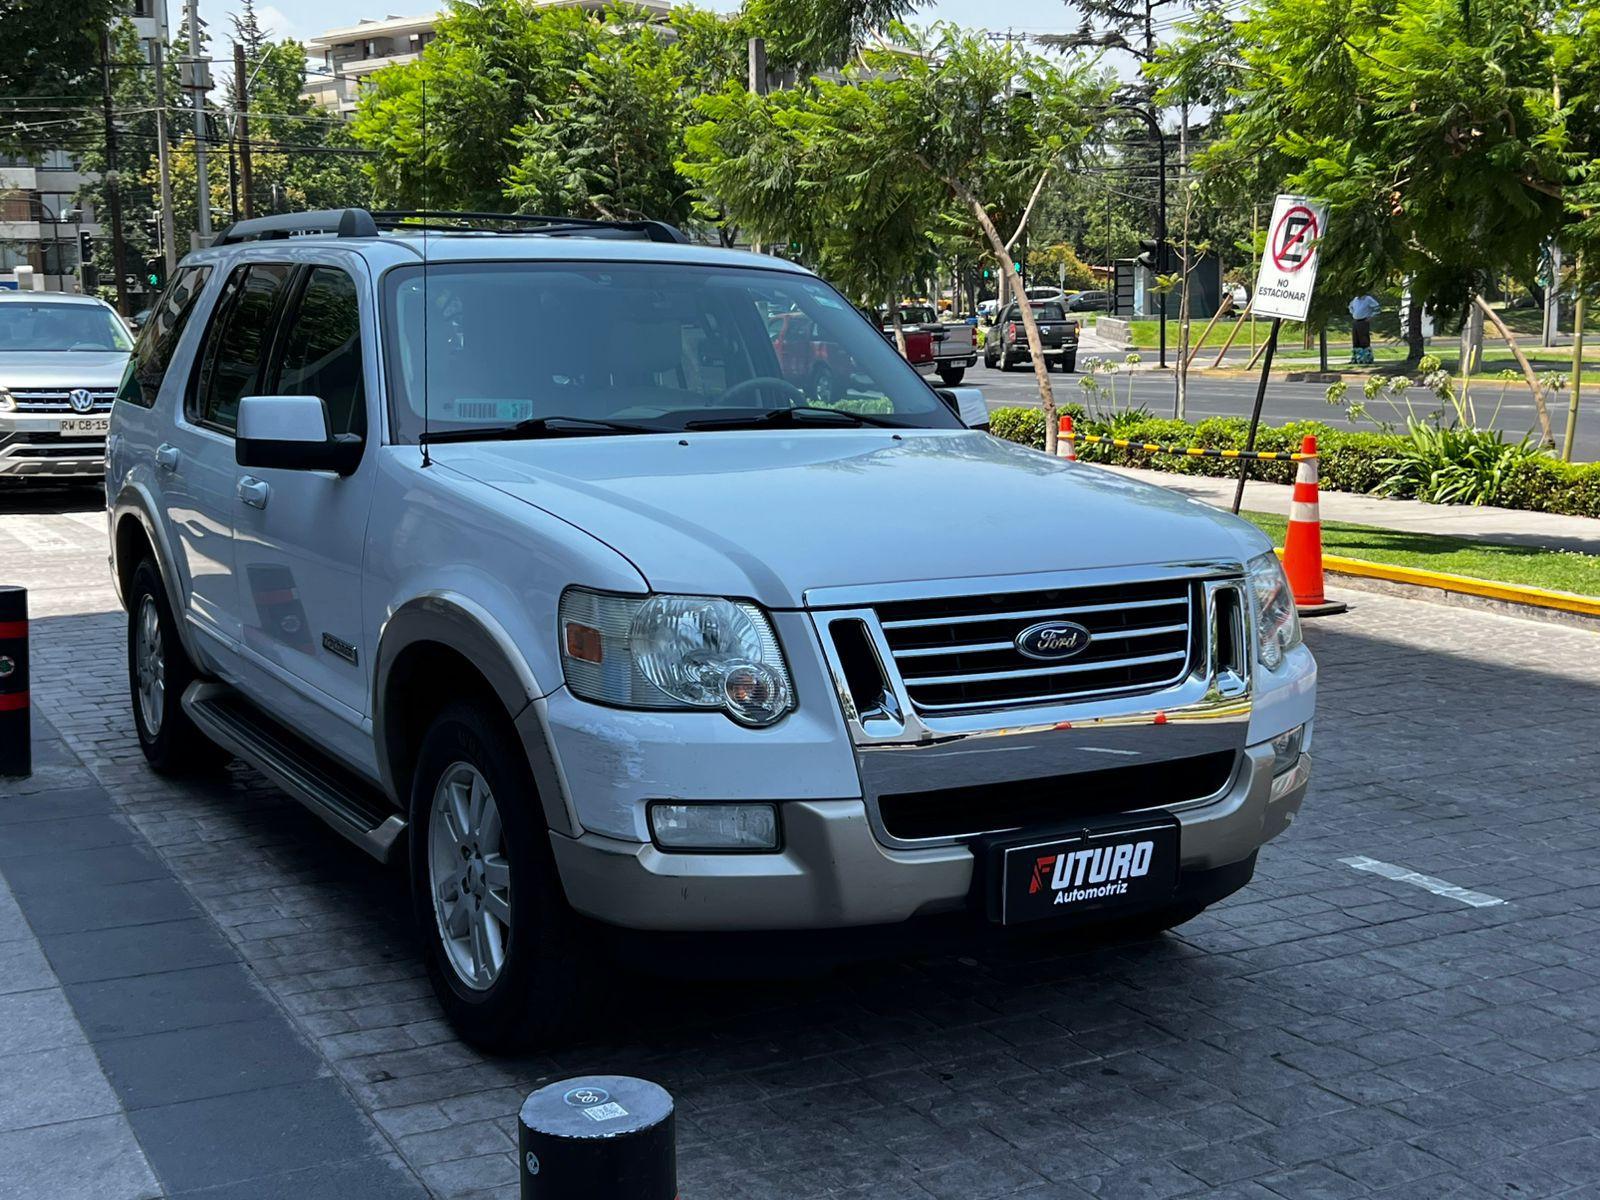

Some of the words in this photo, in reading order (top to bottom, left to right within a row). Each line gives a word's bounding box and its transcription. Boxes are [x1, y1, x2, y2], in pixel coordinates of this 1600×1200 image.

[1258, 286, 1306, 301] ESTACIONAR
[1277, 278, 1289, 288] NO
[1037, 629, 1077, 650] Ford
[1028, 840, 1154, 894] FUTURO
[1053, 880, 1128, 905] Automotriz
